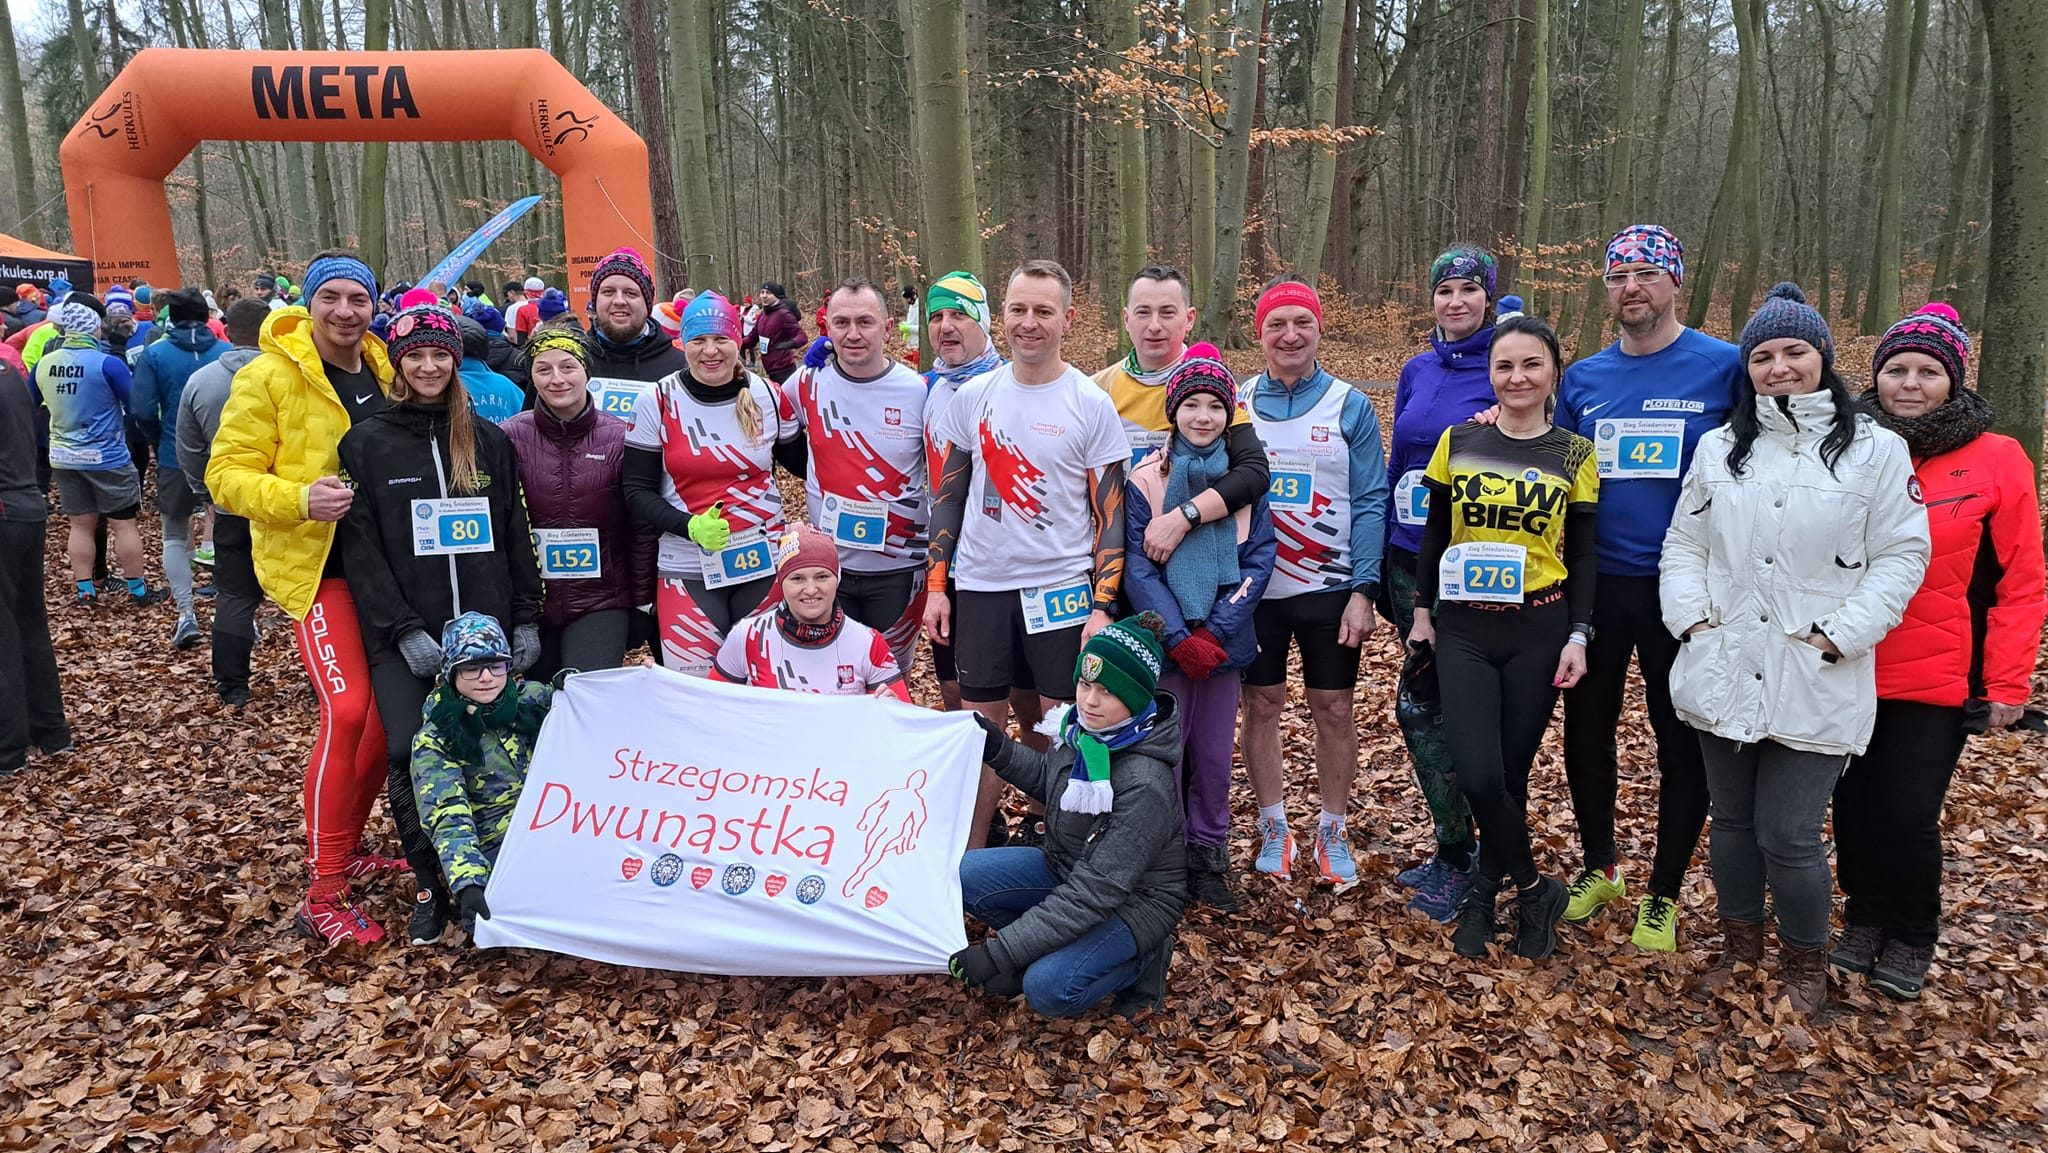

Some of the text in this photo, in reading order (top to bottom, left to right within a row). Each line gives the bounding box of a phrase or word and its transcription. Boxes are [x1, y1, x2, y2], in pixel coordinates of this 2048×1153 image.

[252, 66, 421, 119] META
[122, 91, 140, 150] HERKULES
[538, 99, 556, 156] HERKULES
[119, 260, 151, 269] IMPREZ
[49, 365, 84, 378] ARCZI
[56, 382, 78, 395] #17
[1630, 442, 1664, 464] 42
[1270, 477, 1299, 498] 43
[452, 519, 480, 541] 80
[854, 521, 867, 539] 6
[1462, 502, 1552, 536] BIEG
[551, 548, 593, 568] 152
[734, 549, 761, 570] 48
[1469, 566, 1516, 589] 276
[1050, 590, 1090, 617] 164
[311, 602, 346, 694] POLSKA
[609, 747, 848, 806] Strzegomska
[529, 782, 835, 866] Dwunastka
